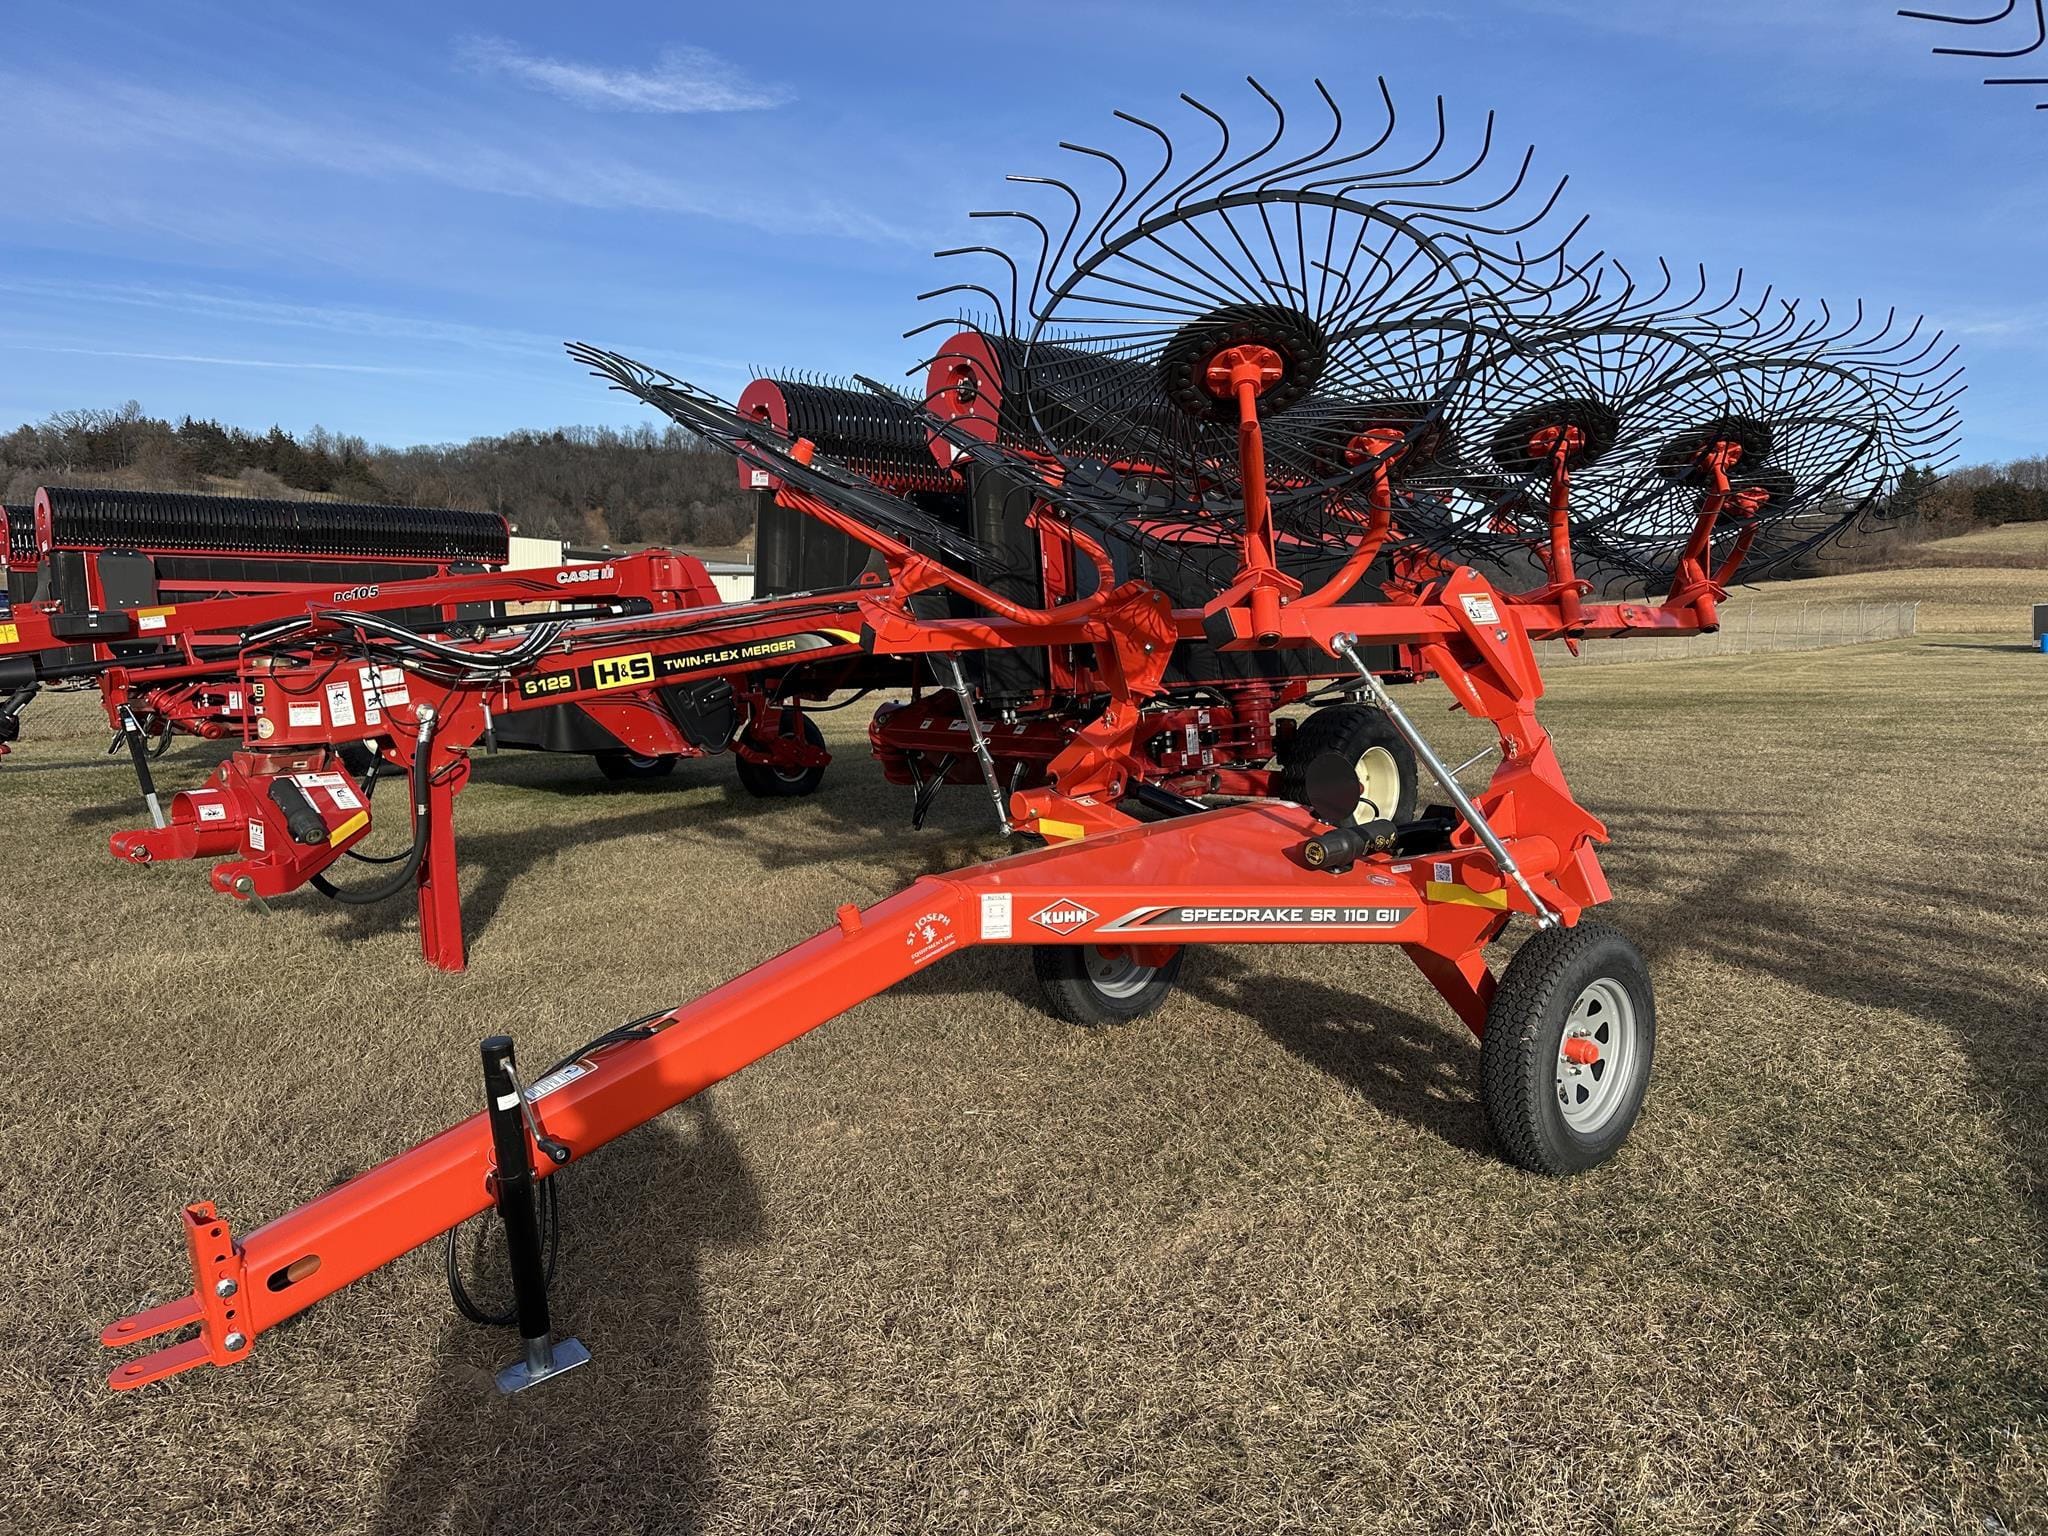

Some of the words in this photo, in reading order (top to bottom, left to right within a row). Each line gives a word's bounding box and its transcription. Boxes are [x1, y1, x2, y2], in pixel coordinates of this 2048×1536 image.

[556, 569, 599, 584] CASE
[334, 585, 379, 602] DC105
[664, 649, 739, 671] TWIN-FLEX
[741, 640, 796, 658] MERGER
[598, 658, 650, 685] H&S
[1041, 910, 1088, 924] KUHN
[1180, 909, 1303, 922] SPEEDRAKE
[1310, 909, 1336, 922] SR
[1343, 909, 1369, 922] 110
[1376, 909, 1400, 922] GII
[906, 930, 917, 946] ST.
[915, 912, 951, 930] JOSEPH
